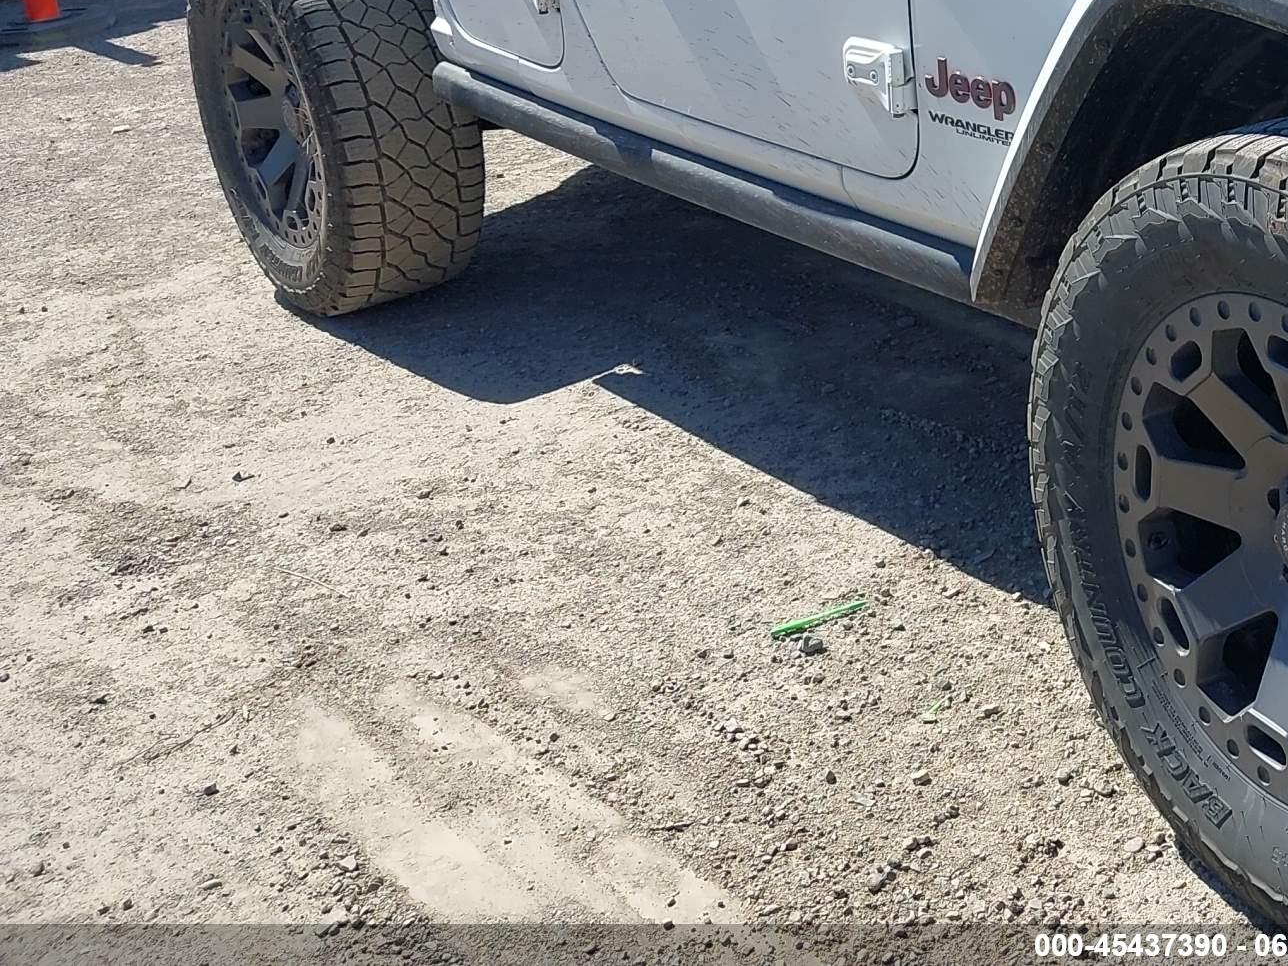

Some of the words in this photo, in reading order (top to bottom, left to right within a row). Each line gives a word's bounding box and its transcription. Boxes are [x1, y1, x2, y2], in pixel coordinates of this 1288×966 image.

[925, 55, 1016, 122] Jeep
[928, 110, 1015, 141] WRANGLER
[956, 128, 1011, 146] UNLIMITE
[1281, 521, 1288, 552] HARD
[1140, 721, 1233, 831] BACK
